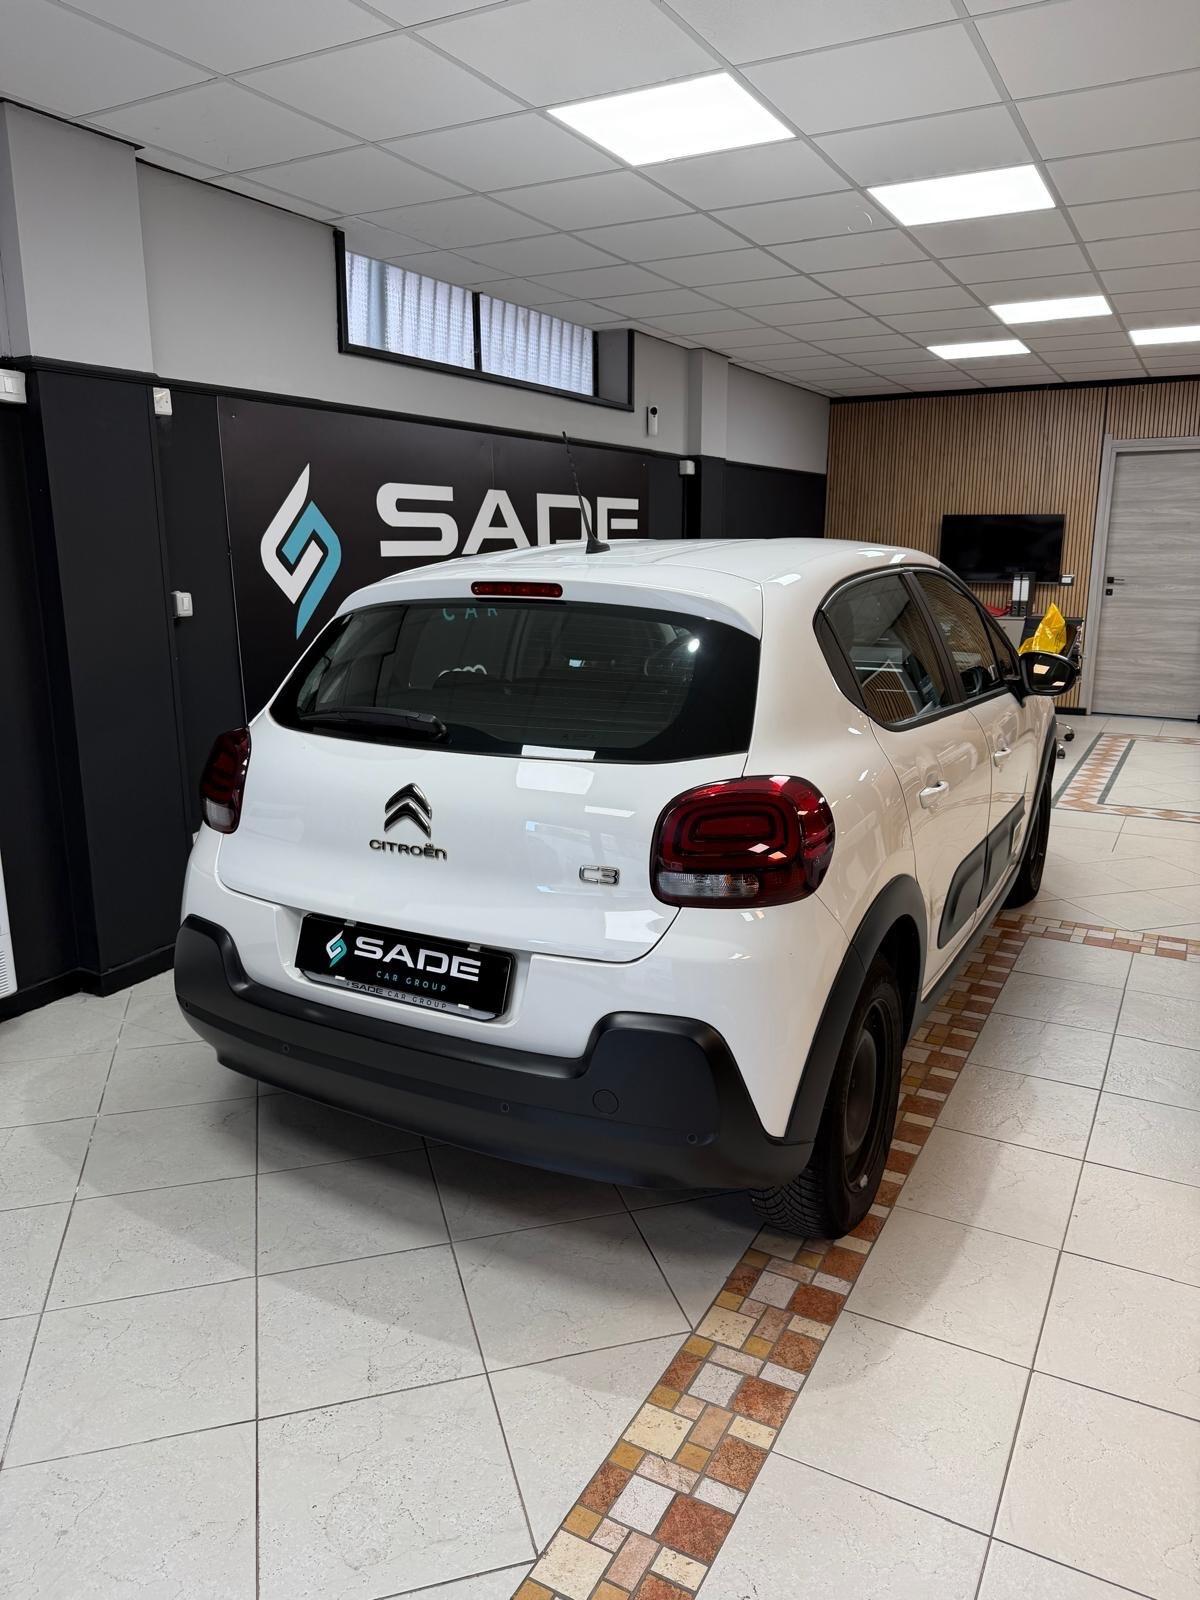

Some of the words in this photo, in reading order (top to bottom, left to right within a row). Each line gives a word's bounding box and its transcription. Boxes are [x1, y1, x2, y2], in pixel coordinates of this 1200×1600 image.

[376, 482, 639, 557] SADE
[578, 864, 620, 886] C3
[354, 936, 481, 982] SADE
[376, 970, 398, 982] CAR
[405, 977, 447, 992] GROUP
[351, 982, 384, 994] SADE
[387, 990, 406, 1000] CAR
[412, 996, 447, 1009] GROUP
